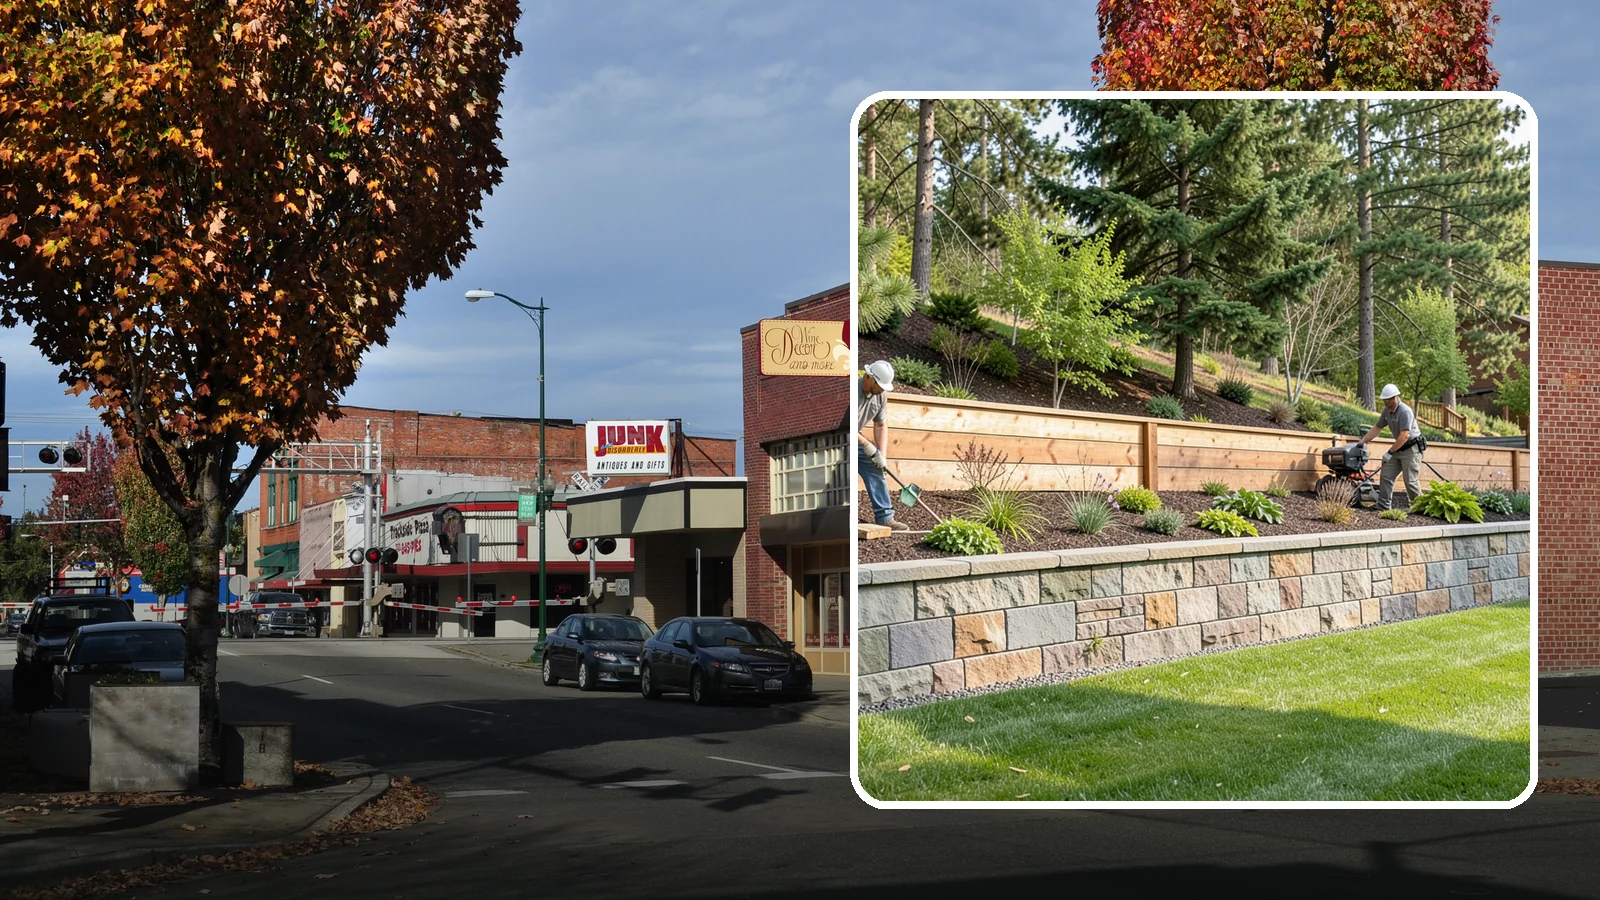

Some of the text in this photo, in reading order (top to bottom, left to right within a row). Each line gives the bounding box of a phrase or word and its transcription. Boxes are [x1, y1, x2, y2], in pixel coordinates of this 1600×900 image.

[765, 327, 831, 365] Decor
[595, 425, 665, 457] JUNK
[607, 446, 646, 454] DISORDERLY
[597, 460, 665, 470] ANTIQUES AND GIFTS
[390, 520, 429, 539] Trackside Pizza
